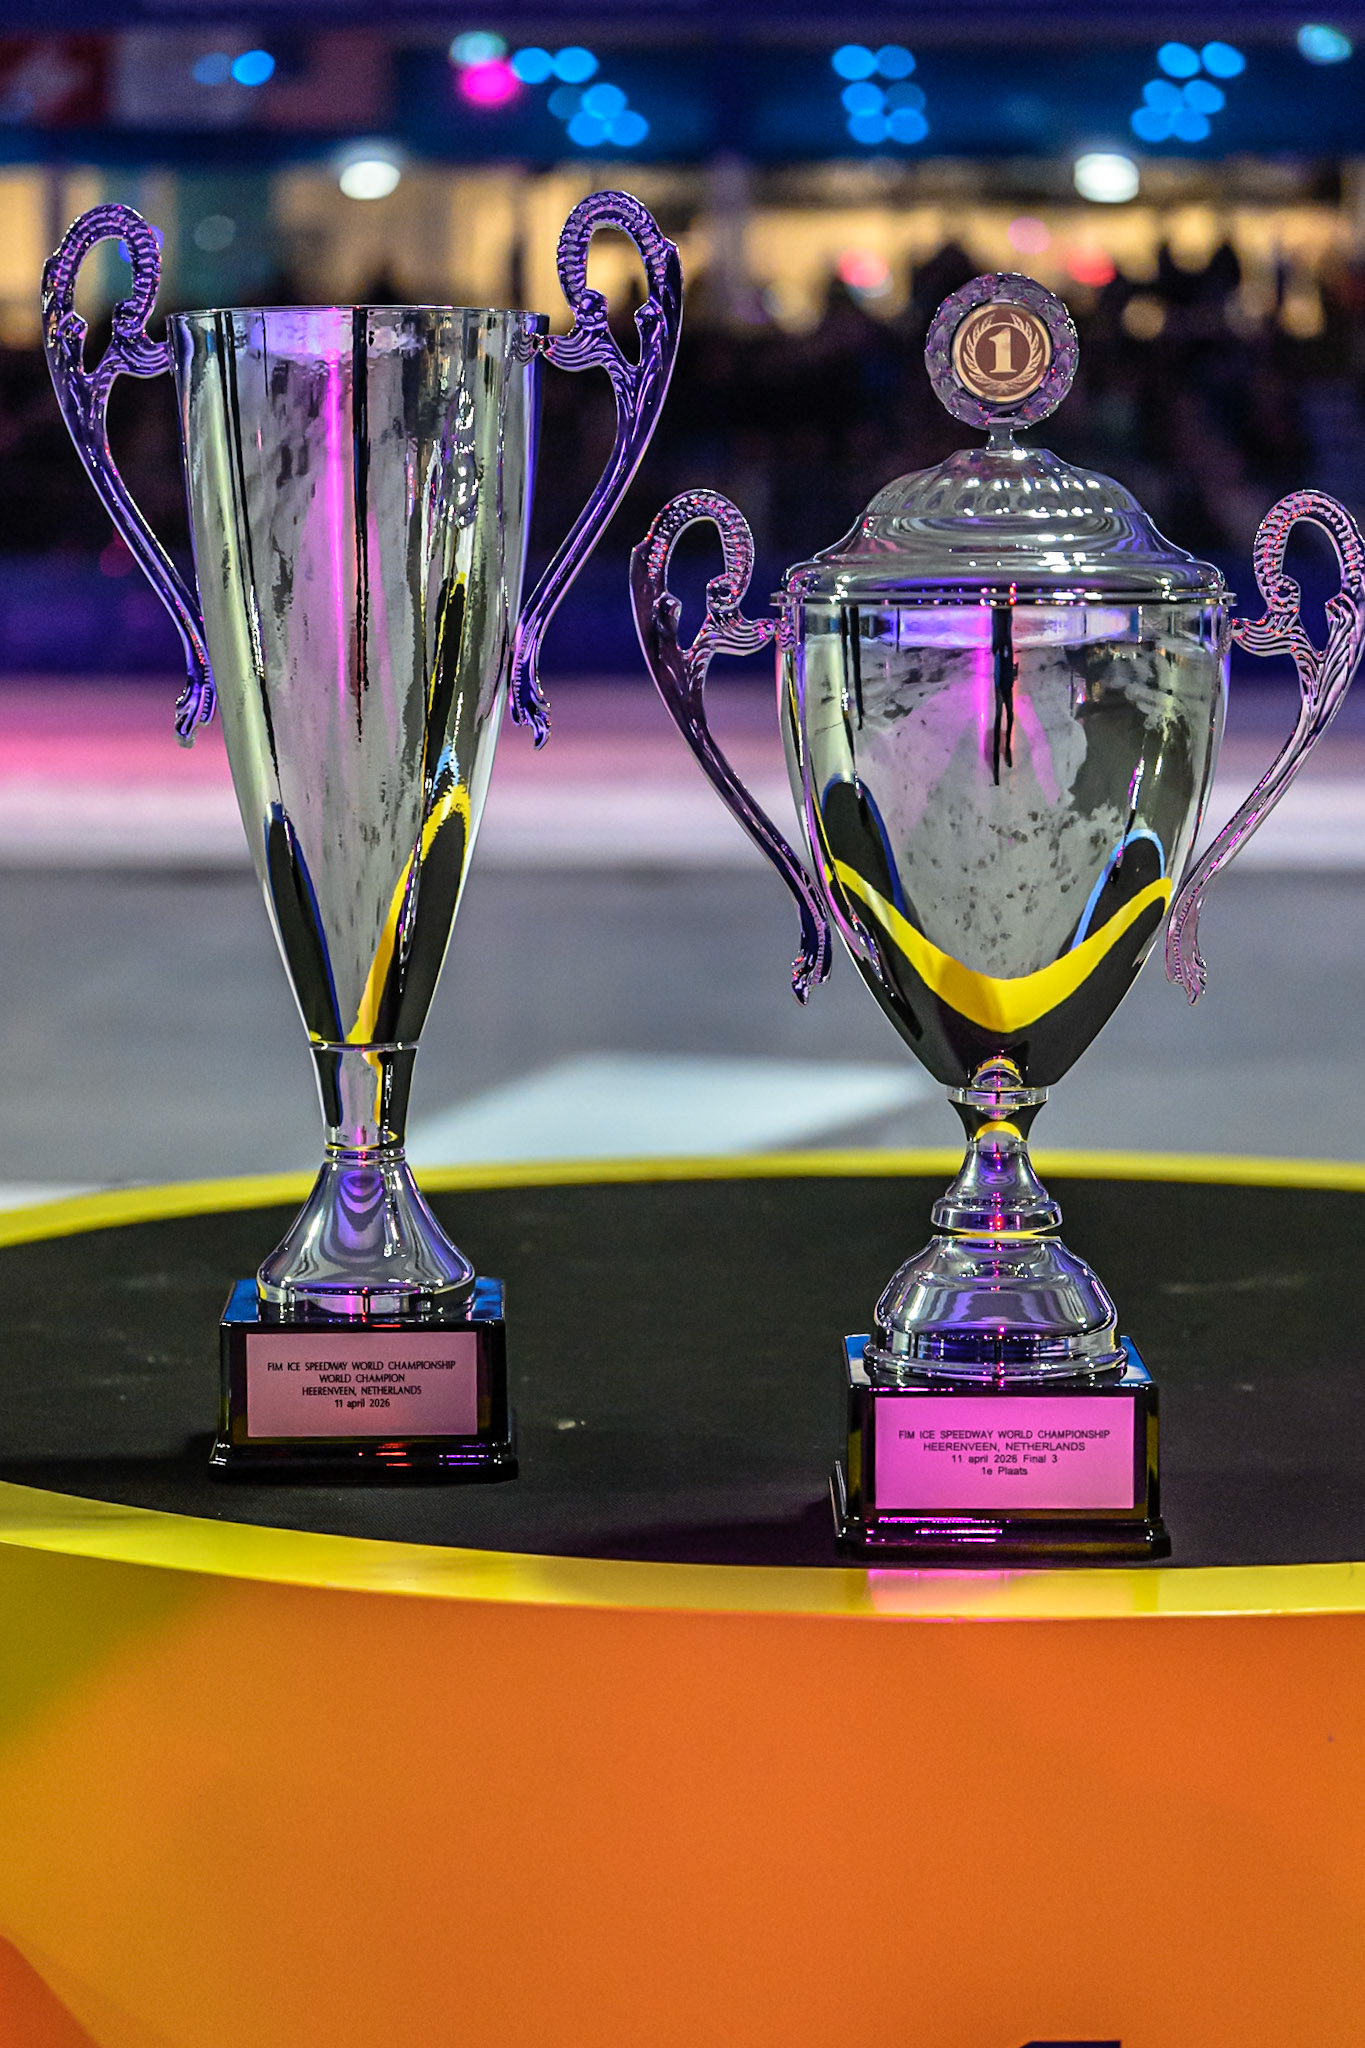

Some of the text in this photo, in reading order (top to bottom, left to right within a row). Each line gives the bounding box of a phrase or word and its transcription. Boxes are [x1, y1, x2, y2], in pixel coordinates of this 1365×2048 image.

[988, 327, 1018, 374] 1
[267, 1360, 456, 1371] FIM ICE SPEEDWAY WORLD CHAMPIONSHIP
[319, 1373, 406, 1383] WORLD CHAMPION
[302, 1385, 422, 1396] HEERENVEEN, NETHERLANDS
[334, 1398, 391, 1410] 11 april 2026
[898, 1430, 1111, 1439] FIM ICE SPEEDWAY WORLD CHAMPIONSHIP
[923, 1442, 1086, 1452] HEERENVEEN, NETHERLANDS
[951, 1454, 1058, 1465] 11 april 2026 Final 3
[981, 1466, 1028, 1476] 1e Plaats
